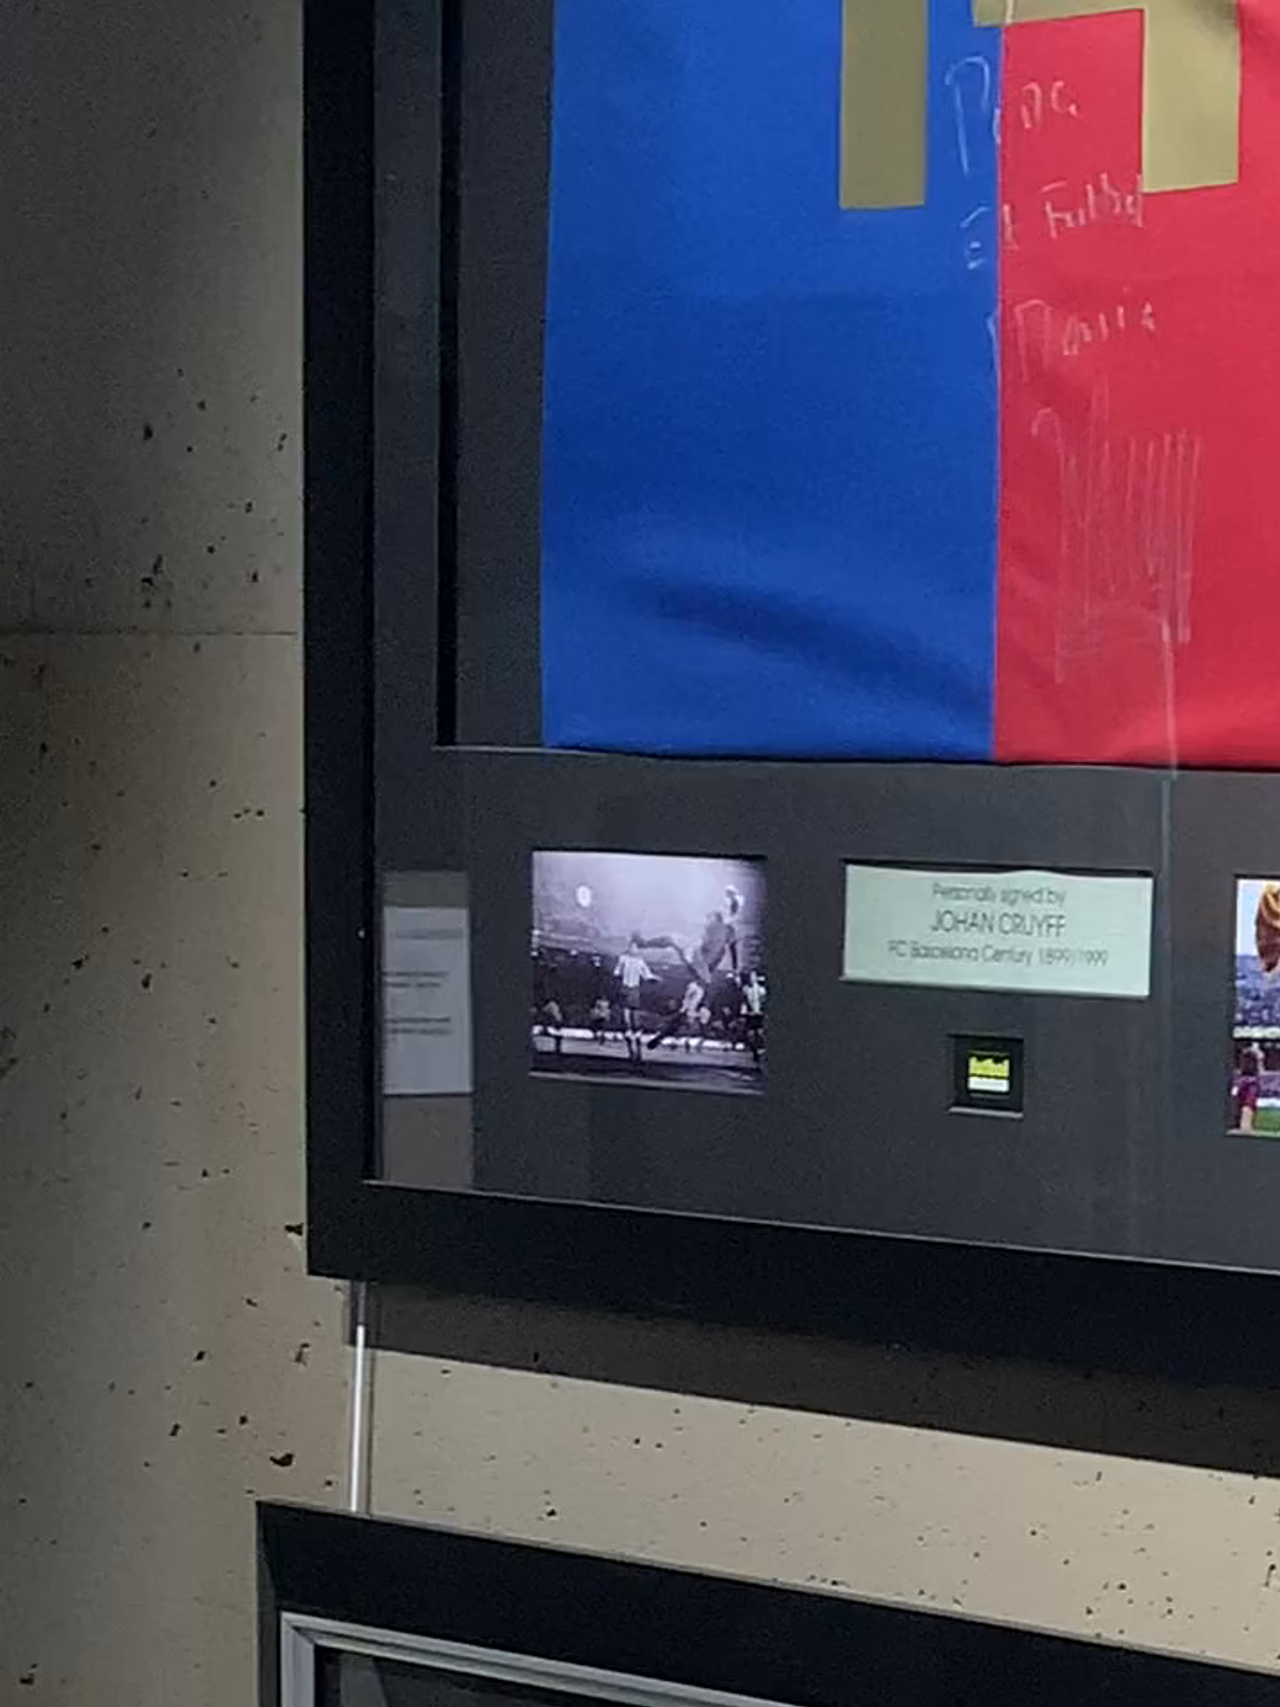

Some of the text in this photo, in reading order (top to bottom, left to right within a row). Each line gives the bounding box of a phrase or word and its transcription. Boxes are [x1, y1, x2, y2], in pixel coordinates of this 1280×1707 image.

[932, 910, 1066, 937] JOHAN CRUYFF
[888, 940, 907, 957] FC
[983, 945, 1033, 966] Century
